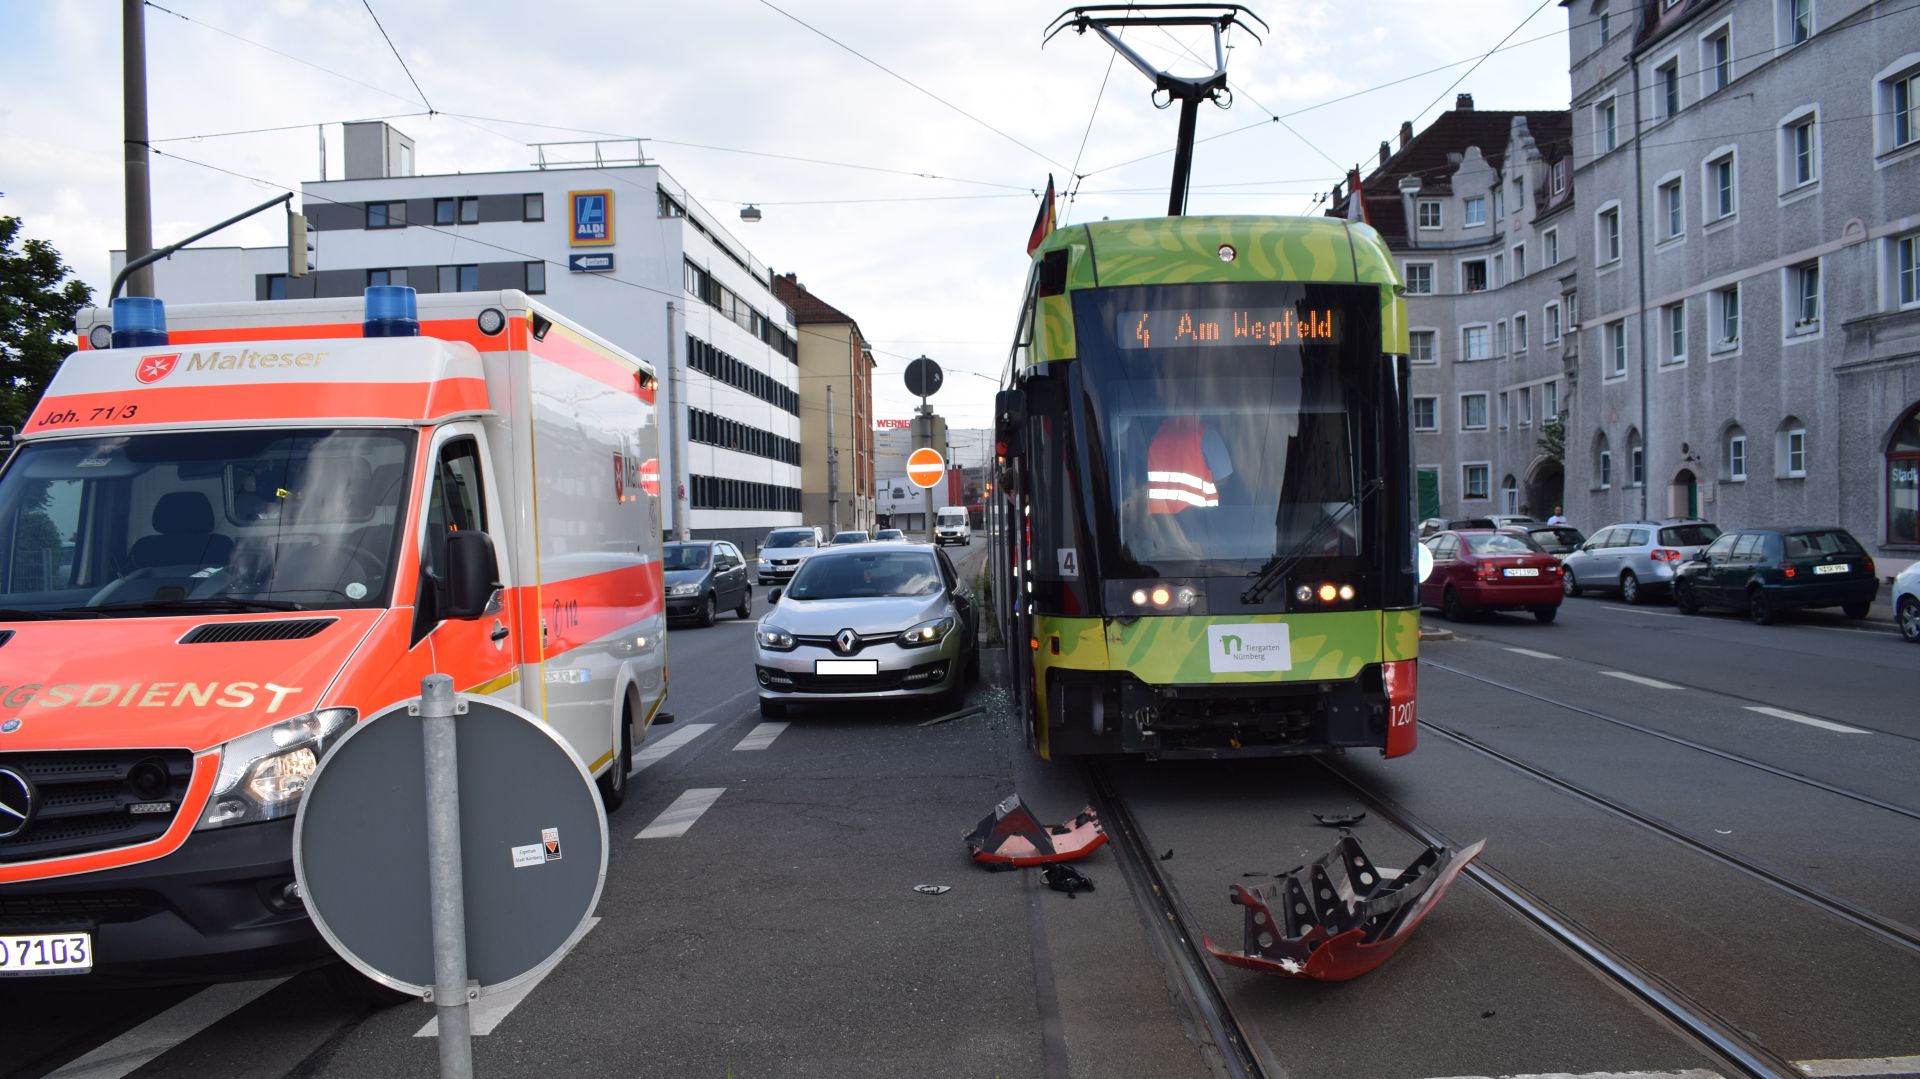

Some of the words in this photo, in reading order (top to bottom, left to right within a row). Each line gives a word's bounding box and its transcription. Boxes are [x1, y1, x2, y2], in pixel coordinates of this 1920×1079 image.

[578, 223, 605, 234] ALDI
[1136, 312, 1150, 349] 4
[1175, 312, 1219, 341] Am
[1234, 309, 1332, 347] Wegfeld
[186, 349, 330, 372] Malteser
[38, 408, 80, 426] Joh.
[88, 405, 138, 422] 71/3
[876, 419, 911, 429] WERNE
[1063, 551, 1076, 574] 4
[565, 599, 578, 628] 112
[1233, 653, 1266, 661] Nürnberg
[1246, 644, 1280, 653] Tiergarten
[1391, 700, 1415, 727] 1207
[16, 937, 86, 966] 7103
